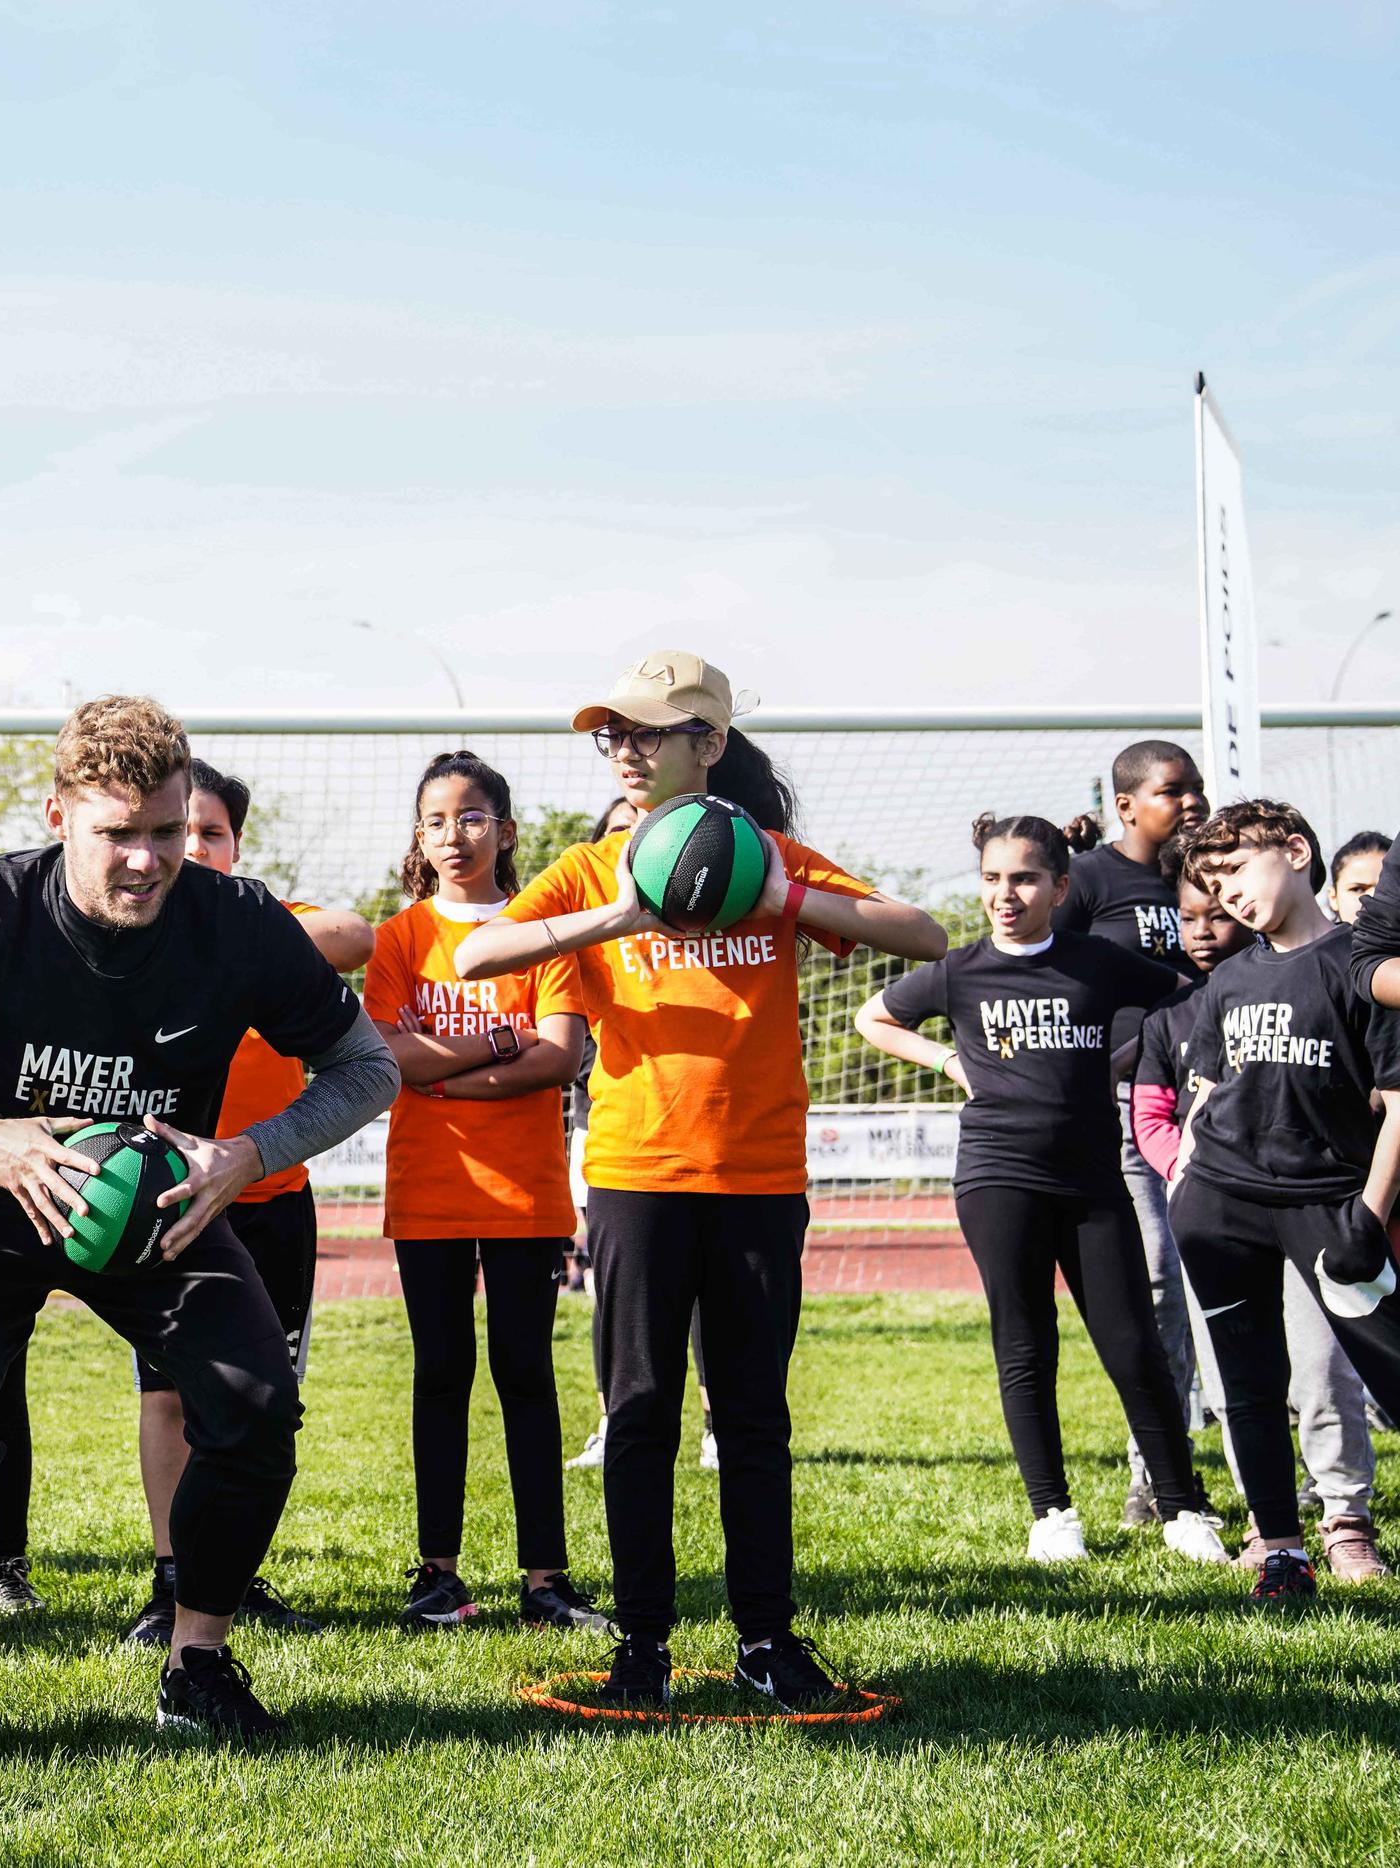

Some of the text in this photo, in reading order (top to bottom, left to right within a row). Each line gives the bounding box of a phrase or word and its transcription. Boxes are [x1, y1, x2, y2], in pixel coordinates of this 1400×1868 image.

[686, 866, 709, 911] amazonbasics
[1135, 905, 1182, 931] MAY
[618, 935, 777, 983] EXPERIENCE
[415, 981, 498, 1014] MAYER
[980, 998, 1070, 1029] MAYER
[420, 1012, 532, 1037] PERIENC
[1223, 1003, 1293, 1041] MAYER
[984, 1025, 1104, 1059] EXPERIENCE
[20, 1043, 134, 1089] MAYER
[15, 1075, 181, 1116] EXPERIENCE
[135, 1218, 163, 1264] amazonbasics
